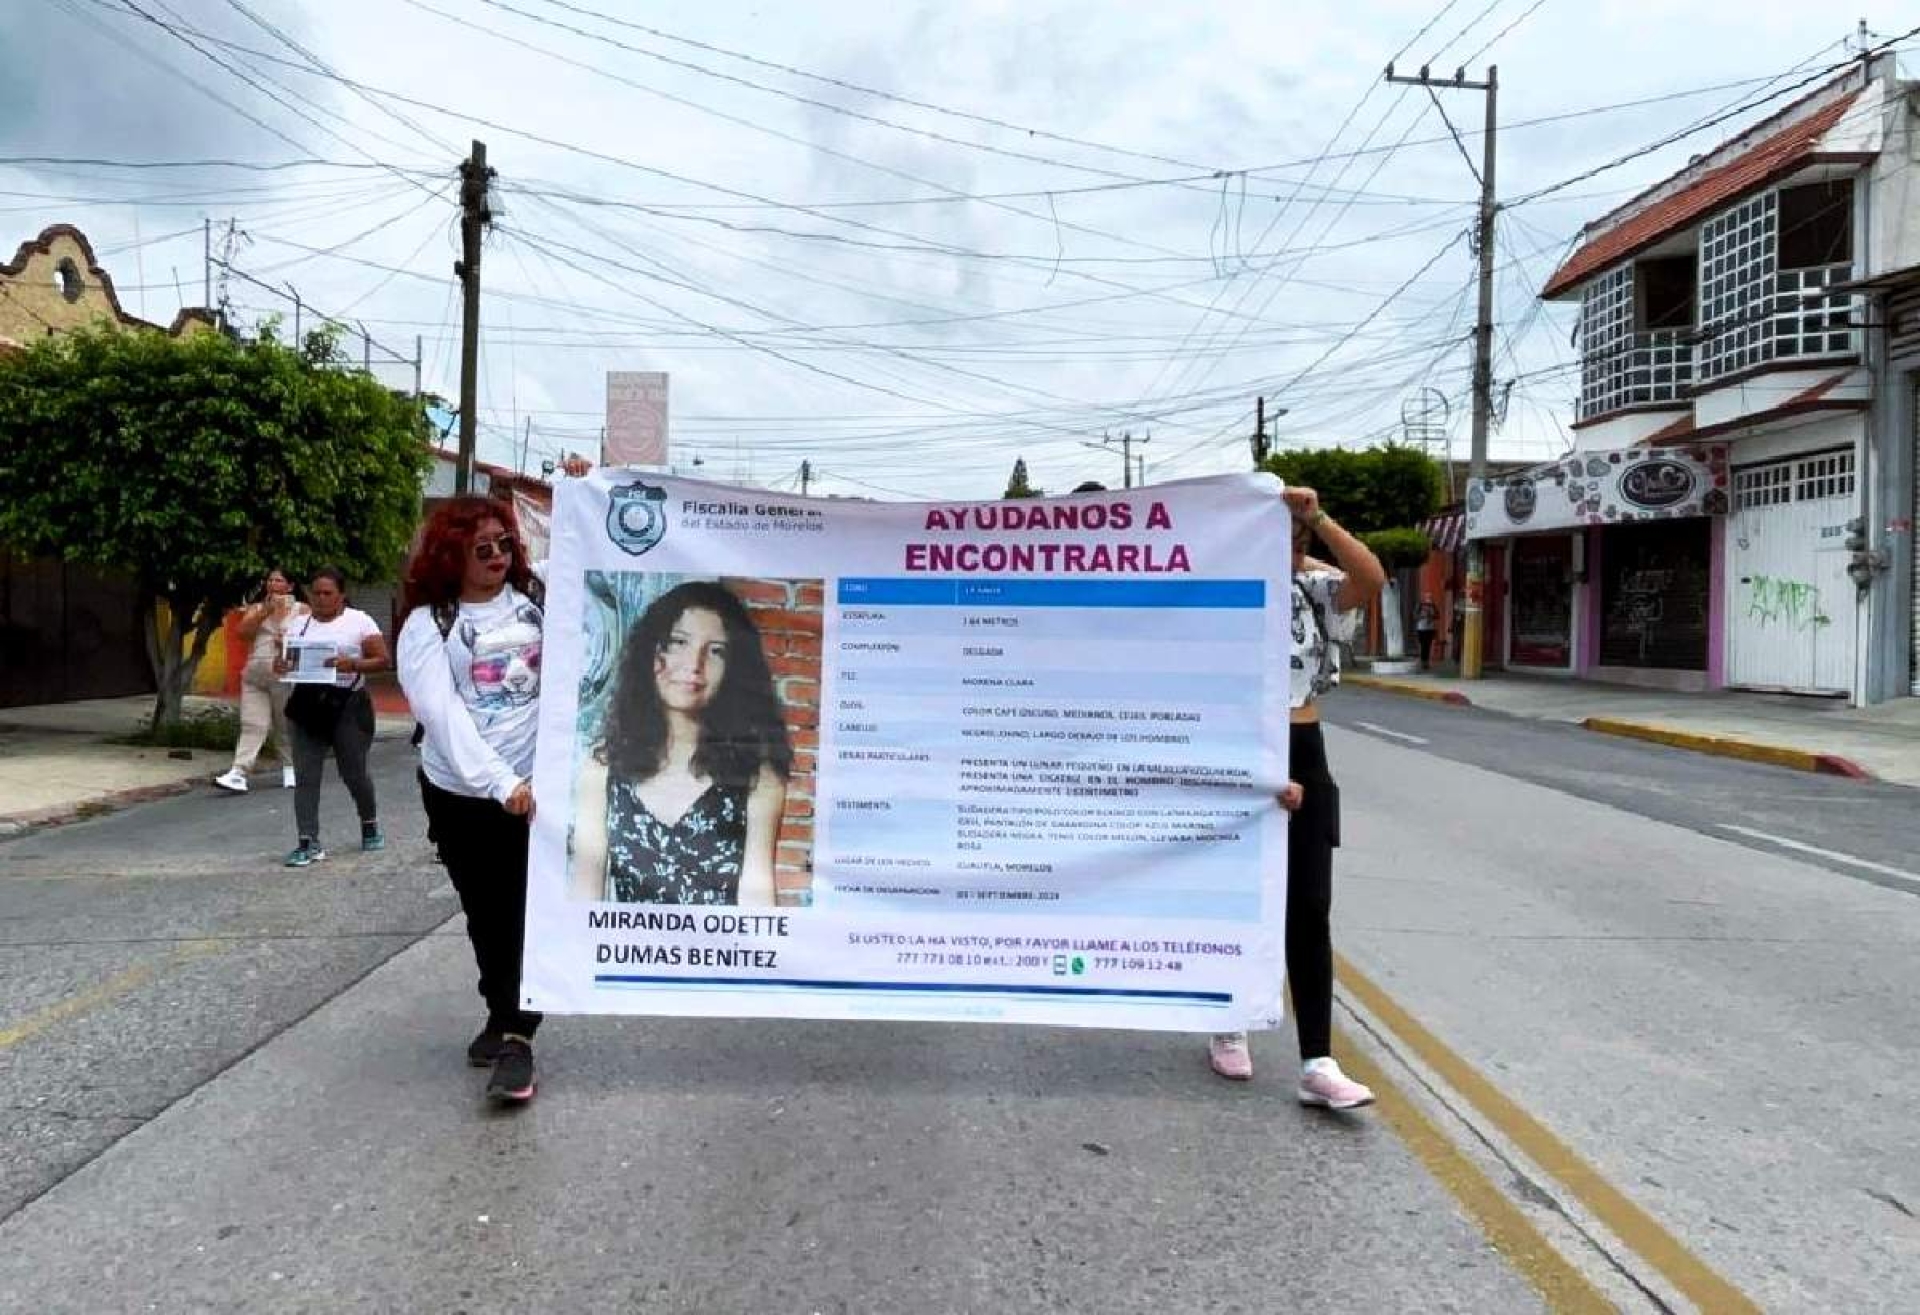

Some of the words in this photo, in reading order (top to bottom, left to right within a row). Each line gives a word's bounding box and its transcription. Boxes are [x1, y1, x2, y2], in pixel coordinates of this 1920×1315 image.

[773, 518, 823, 532] Morelos
[1145, 502, 1173, 530] A
[904, 543, 1191, 572] ENCONTRARLA
[588, 910, 697, 933] MIRANDA
[703, 914, 789, 937] ODETTE
[596, 943, 682, 966] DUMAS
[687, 942, 777, 968] BENÍTEZ
[910, 935, 926, 946] LA
[928, 935, 947, 946] HA
[951, 935, 993, 950] VISTO,
[995, 936, 1022, 948] POR
[1025, 937, 1070, 950] FAVOR
[1073, 939, 1119, 951] LLAME
[1120, 940, 1131, 951] A
[1133, 940, 1159, 953] LOS
